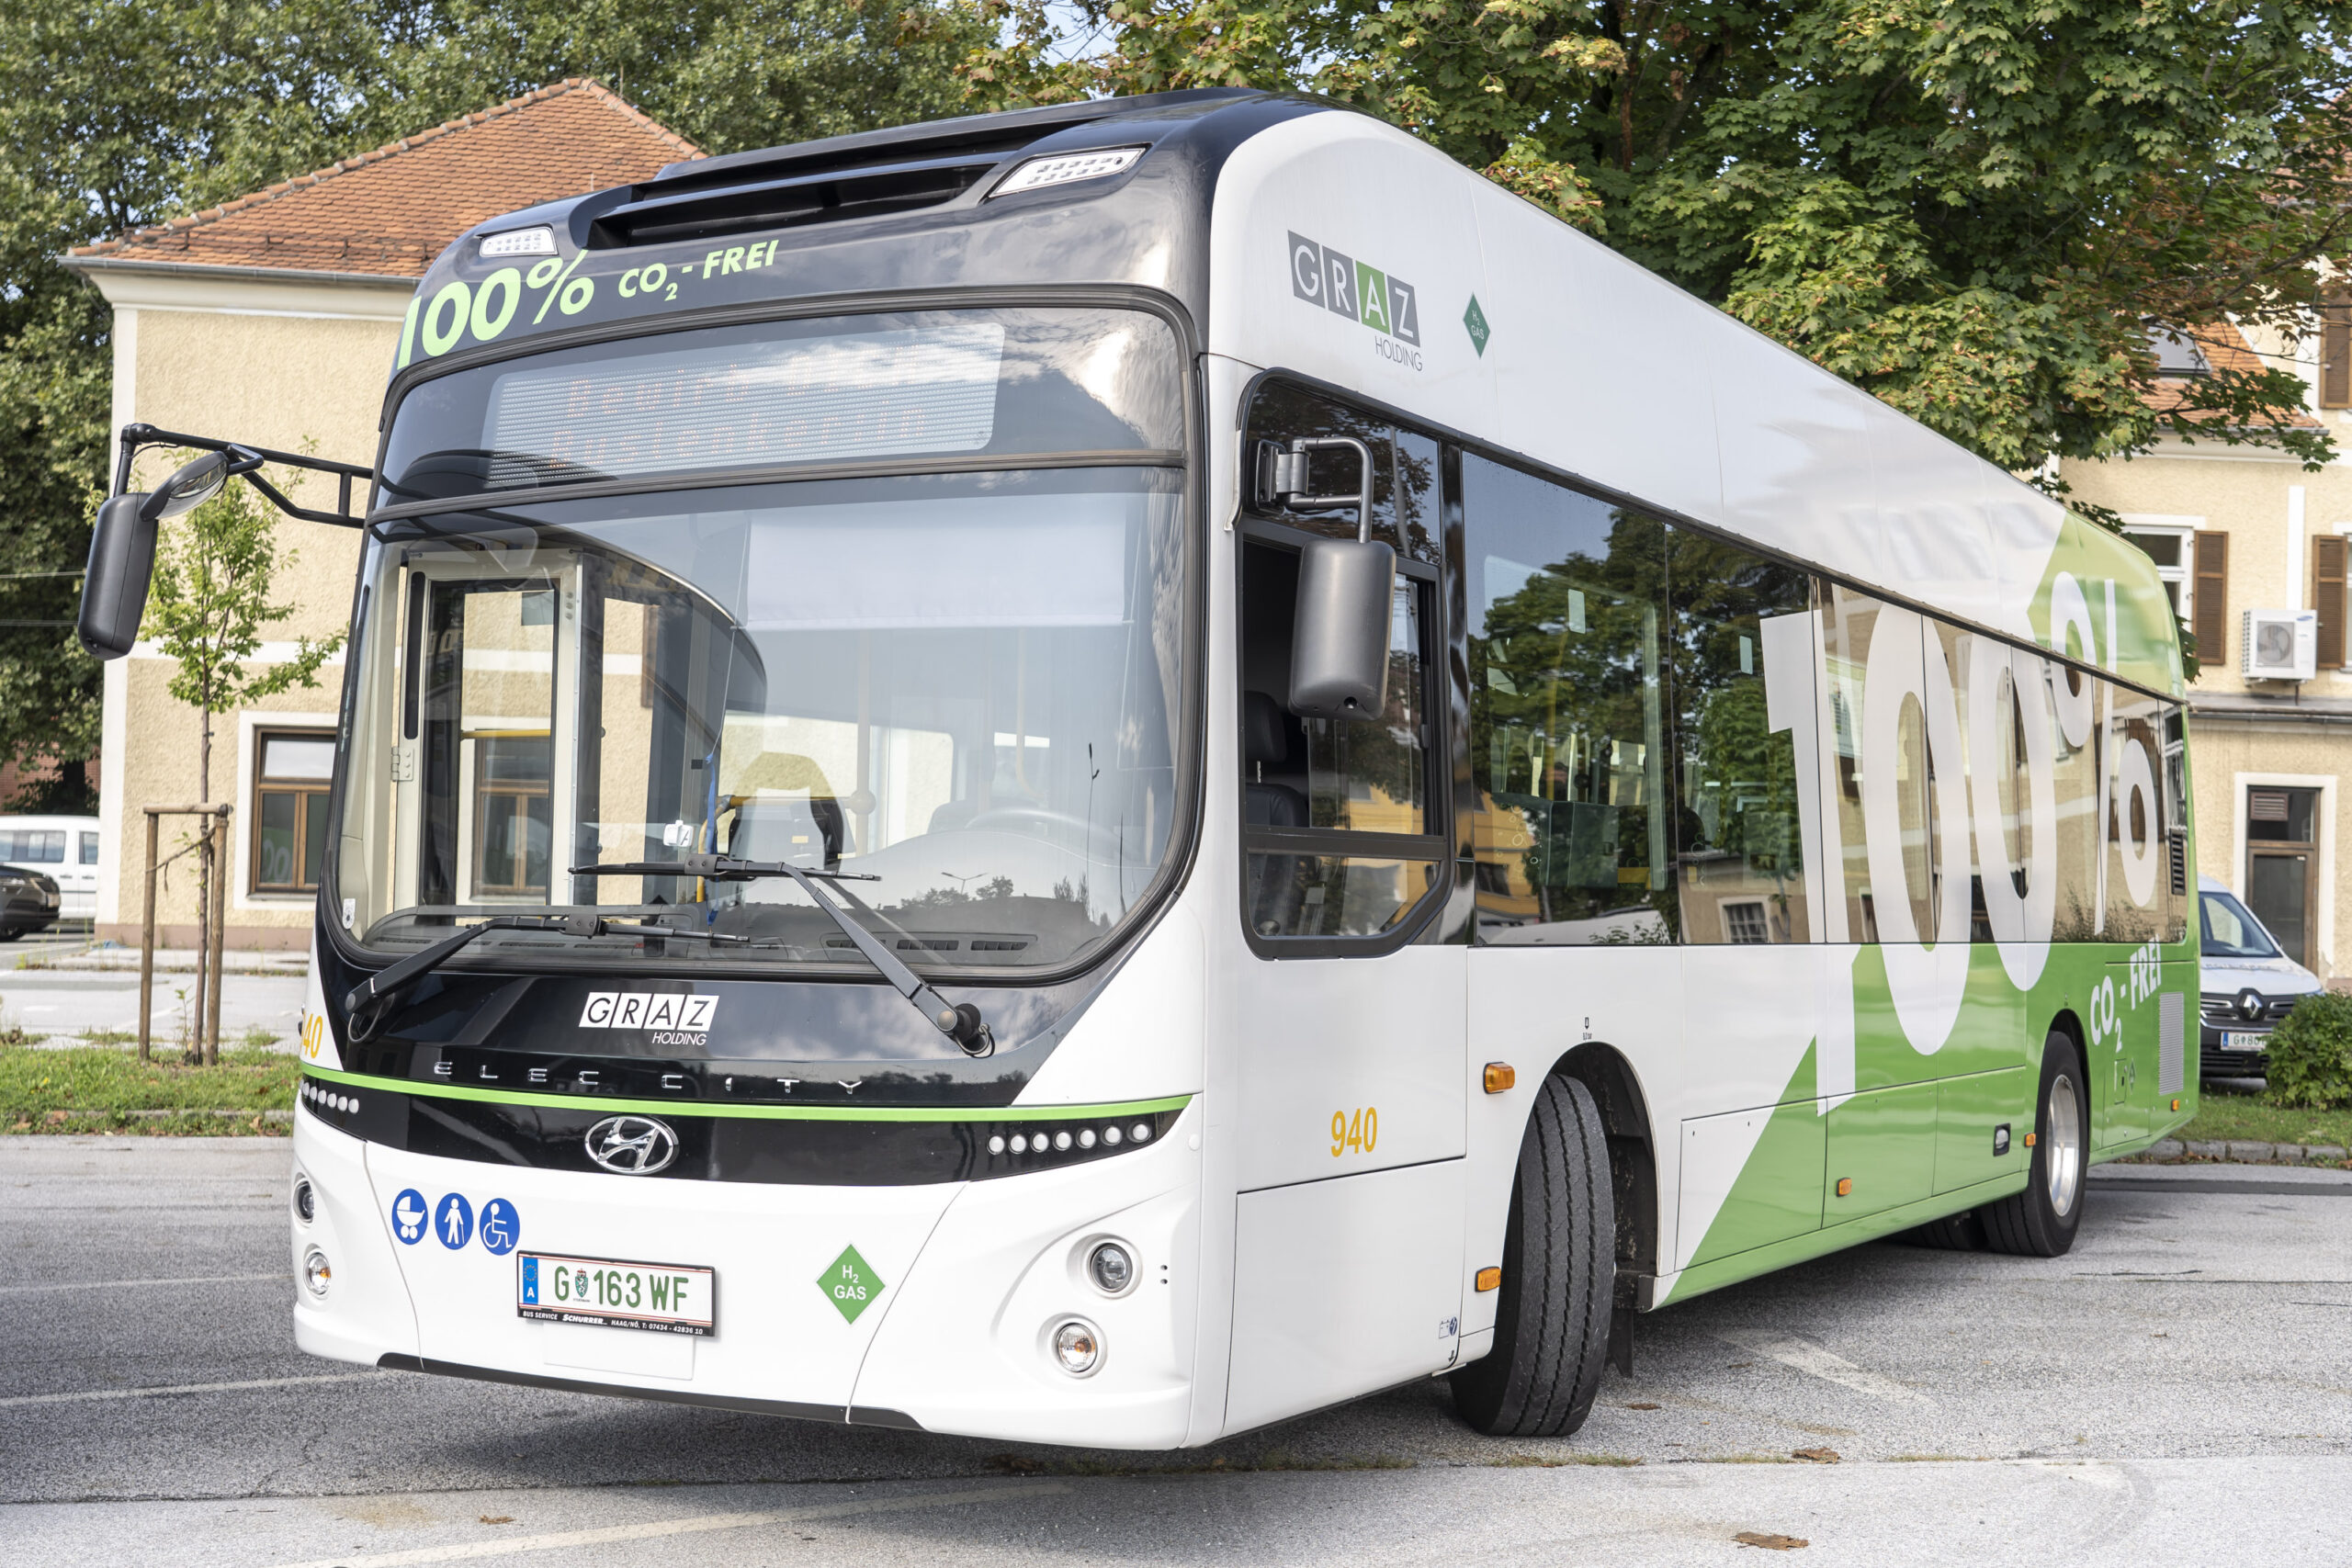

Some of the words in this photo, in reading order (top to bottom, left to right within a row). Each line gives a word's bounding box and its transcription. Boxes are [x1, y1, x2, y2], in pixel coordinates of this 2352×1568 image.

[1294, 244, 1414, 339] GRAZ
[397, 250, 595, 370] 100%
[1471, 324, 1485, 340] GAS
[1374, 335, 1423, 372] HOLDING
[1759, 571, 2157, 1116] 100%
[586, 997, 710, 1027] GRAZ
[652, 1032, 707, 1046] HOLDING
[434, 1061, 599, 1086] ELEC
[662, 1074, 863, 1095] CITY
[1330, 1106, 1378, 1157] 940
[526, 1287, 536, 1298] A
[554, 1266, 570, 1301] G
[594, 1269, 641, 1308] 163
[650, 1274, 689, 1313] WF
[833, 1284, 866, 1301] GAS
[535, 1312, 559, 1320] SERVICE
